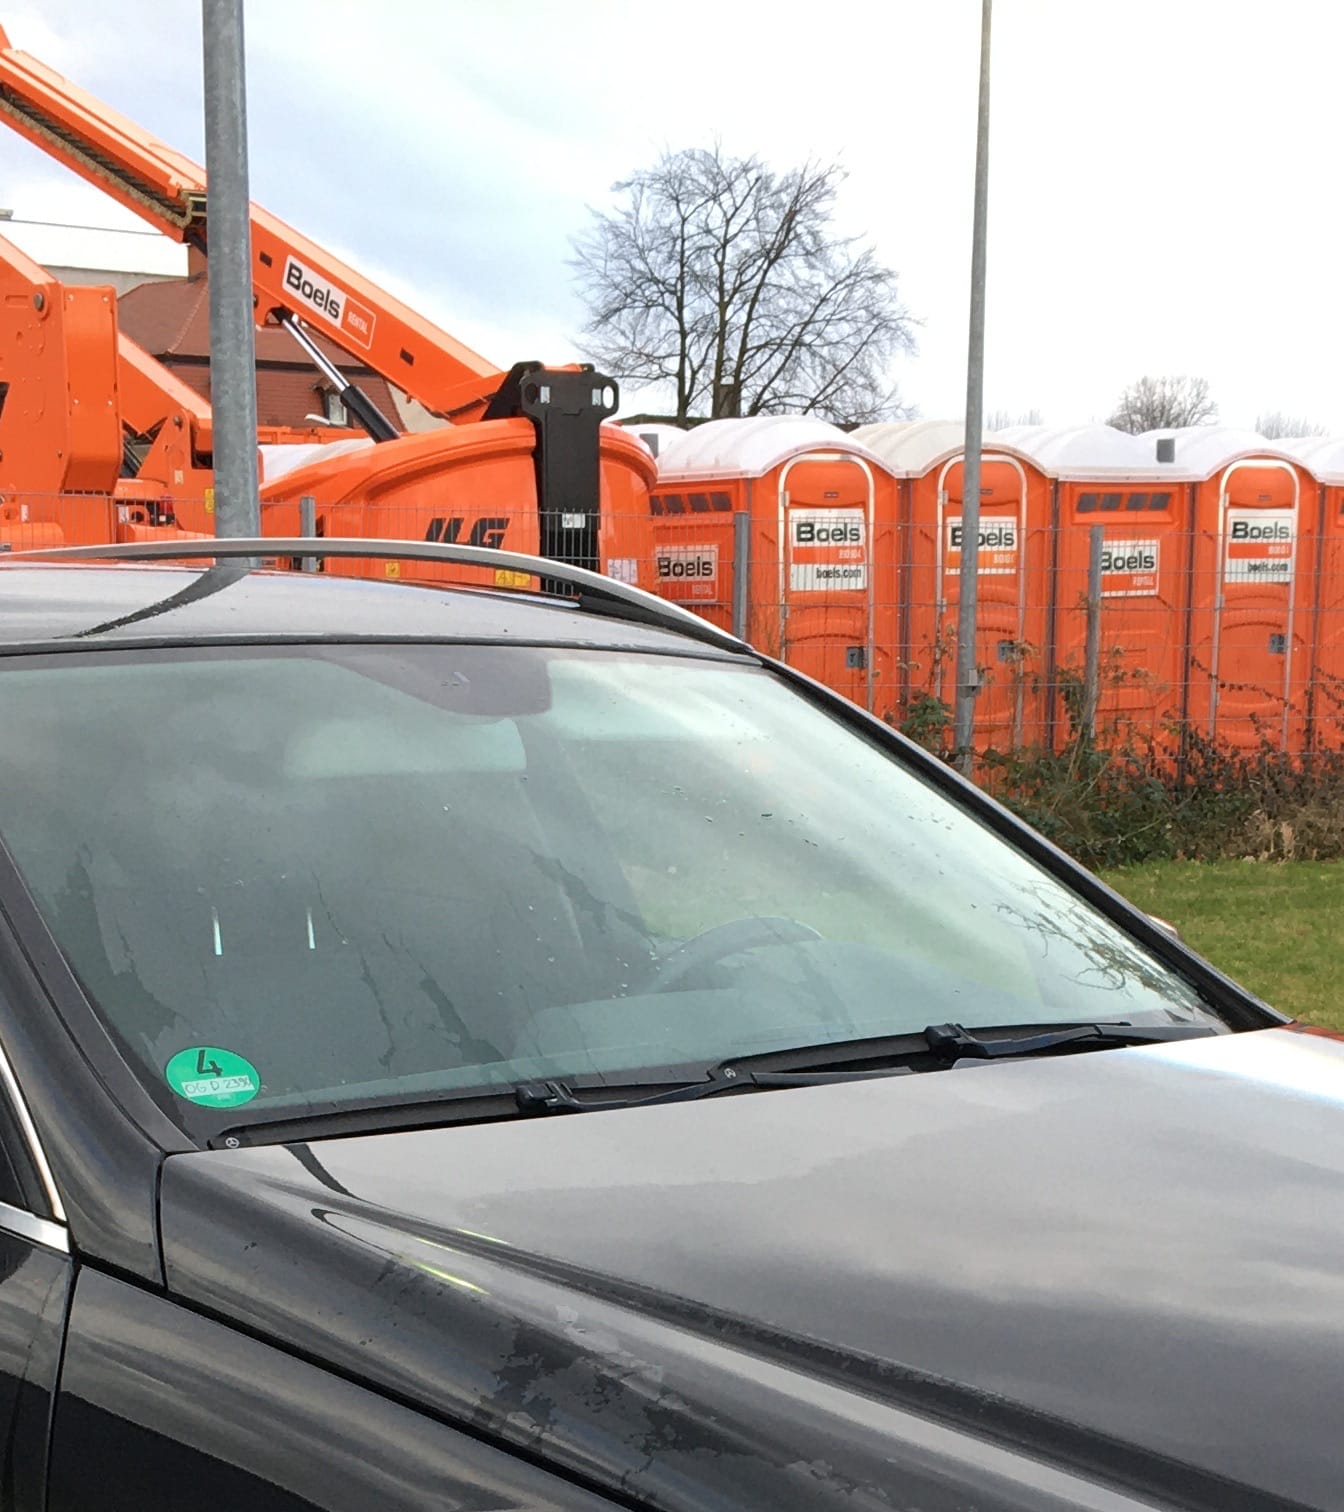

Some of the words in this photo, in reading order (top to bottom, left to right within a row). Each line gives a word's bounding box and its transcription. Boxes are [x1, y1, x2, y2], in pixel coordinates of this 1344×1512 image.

[286, 262, 340, 319] Boels
[348, 311, 368, 335] RENTAL
[796, 522, 861, 542] Boels
[1232, 521, 1289, 539] Boels
[658, 556, 713, 577] Boels
[816, 567, 862, 579] boels.com
[197, 1049, 222, 1076] 4
